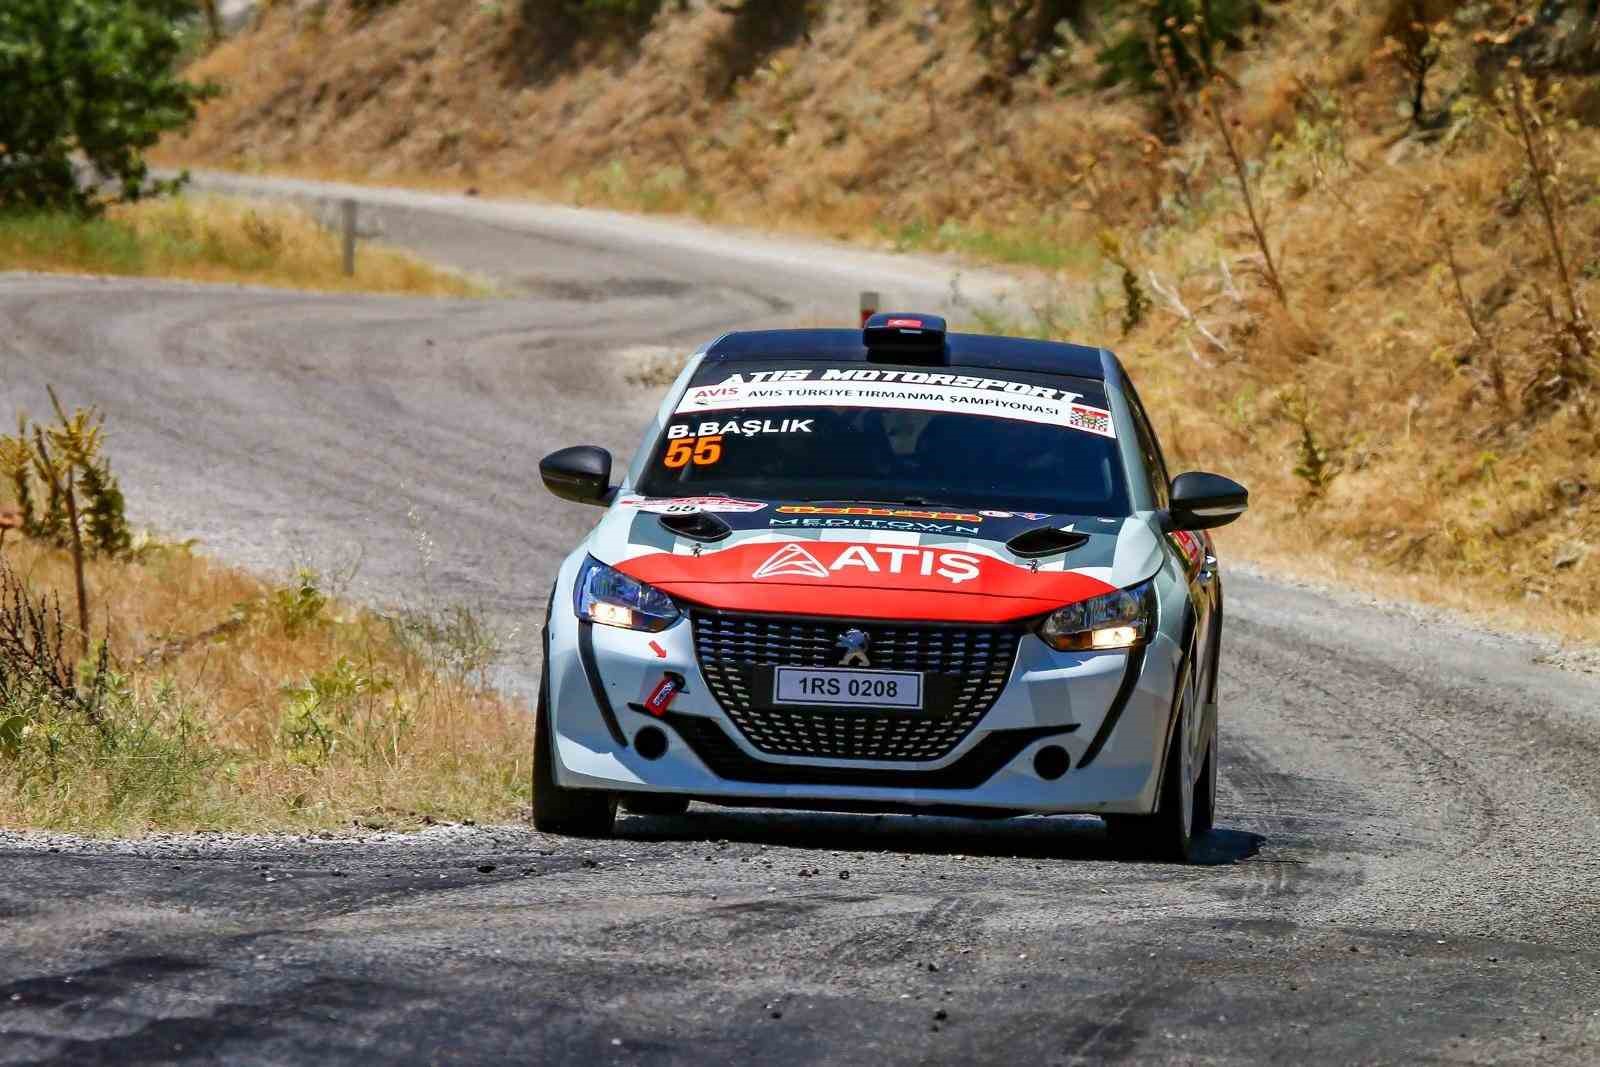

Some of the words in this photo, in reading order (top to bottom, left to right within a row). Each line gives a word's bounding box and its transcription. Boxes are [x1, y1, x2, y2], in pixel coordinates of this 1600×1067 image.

[695, 387, 739, 398] AVIS
[820, 369, 1085, 402] MOTORSPORT
[748, 389, 782, 398] AVIS
[858, 389, 945, 402] TIRMANMA
[949, 394, 1060, 416] ŞAMPİYONASI
[667, 418, 815, 439] B.BAŞLIK
[663, 435, 722, 469] 55
[769, 517, 979, 536] MEDITOWN
[828, 544, 981, 584] ATIŞ
[799, 677, 840, 696] 1RS
[848, 679, 898, 698] 0208
